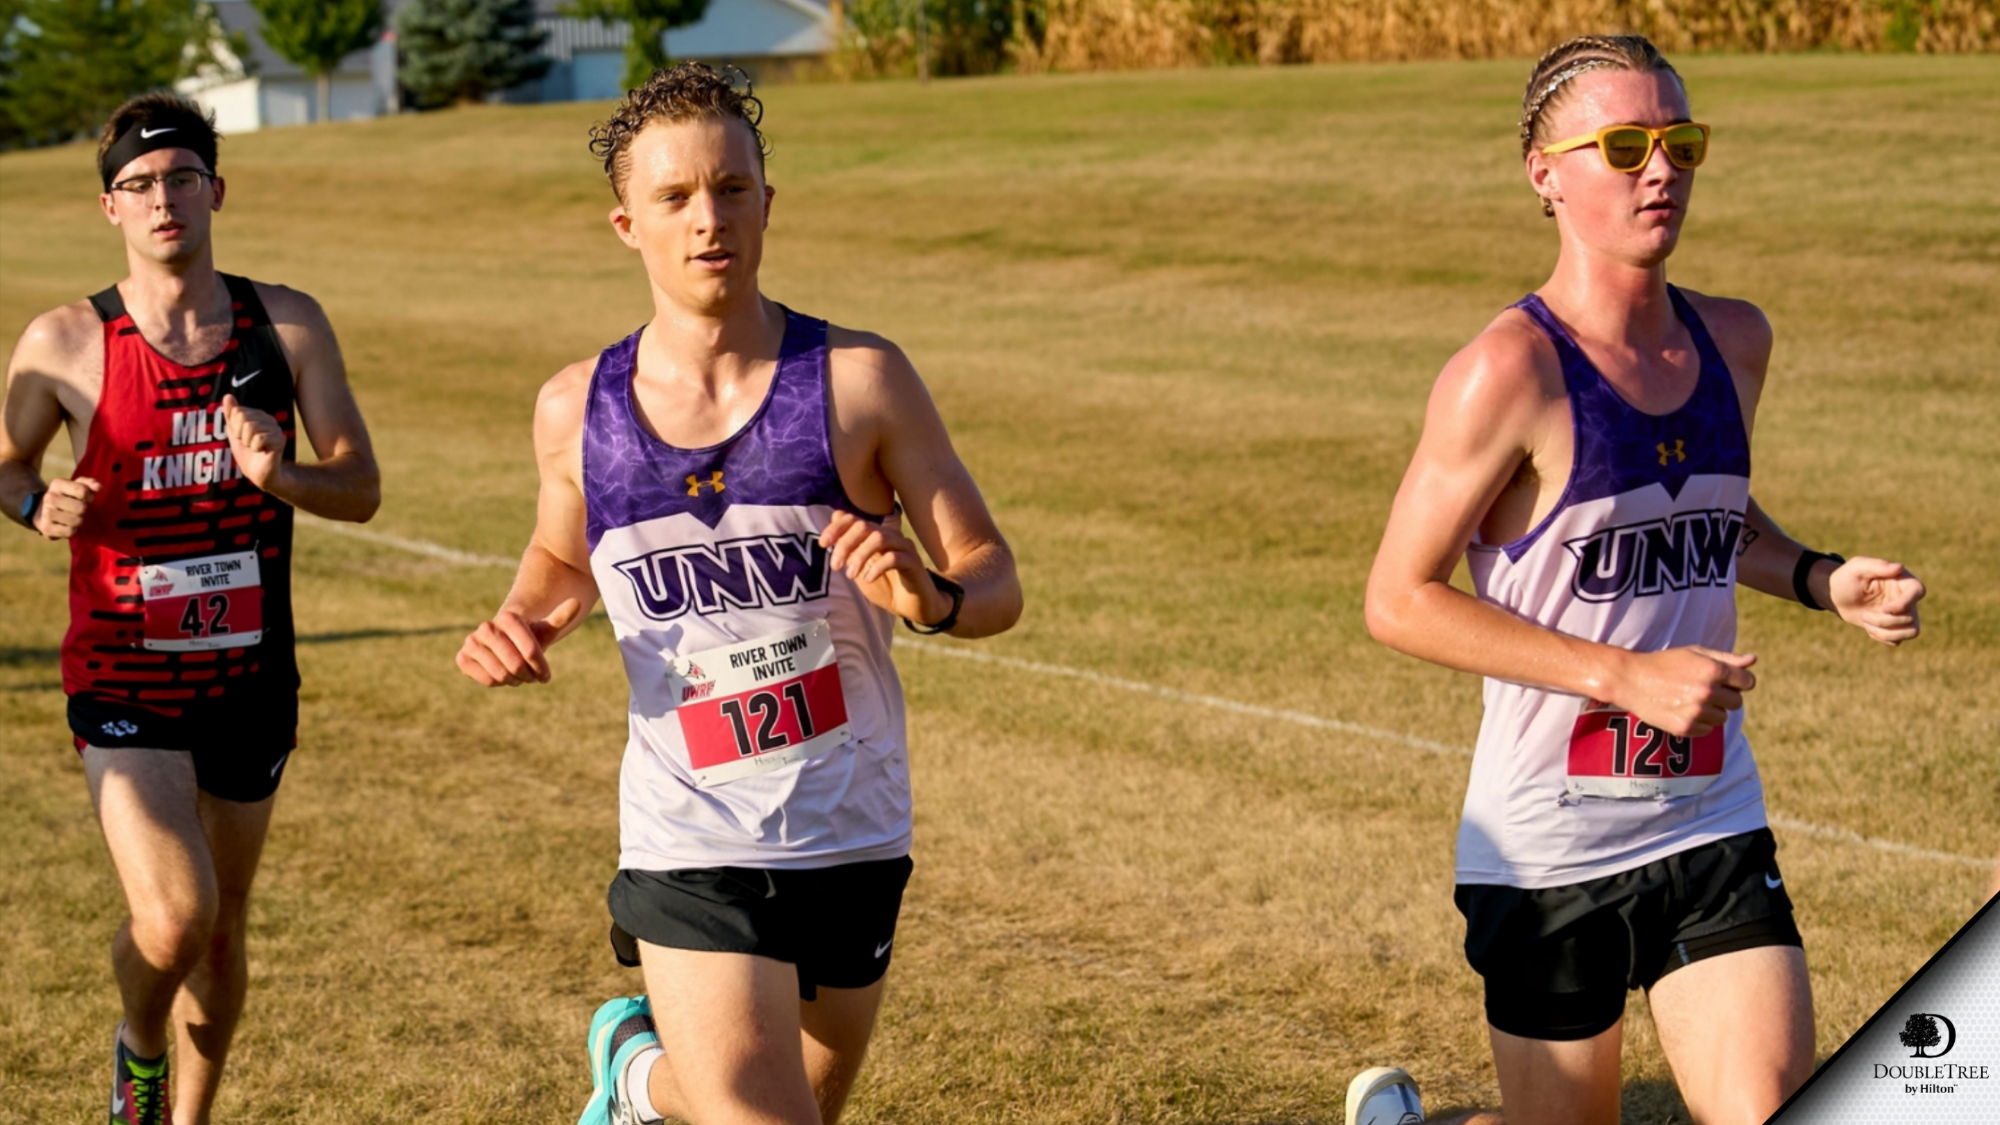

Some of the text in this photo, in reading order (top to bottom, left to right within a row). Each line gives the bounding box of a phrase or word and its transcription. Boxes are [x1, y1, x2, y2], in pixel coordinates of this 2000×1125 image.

[185, 559, 242, 577] RIVER TOWN
[1562, 508, 1745, 603] UNW
[201, 574, 230, 587] INVITE
[612, 532, 834, 621] UNW
[179, 593, 230, 638] 42
[729, 633, 808, 669] RIVER TOWN
[752, 657, 796, 681] INVITE
[681, 680, 716, 702] UWRF
[720, 681, 815, 757] 121
[1606, 716, 1692, 777] 129
